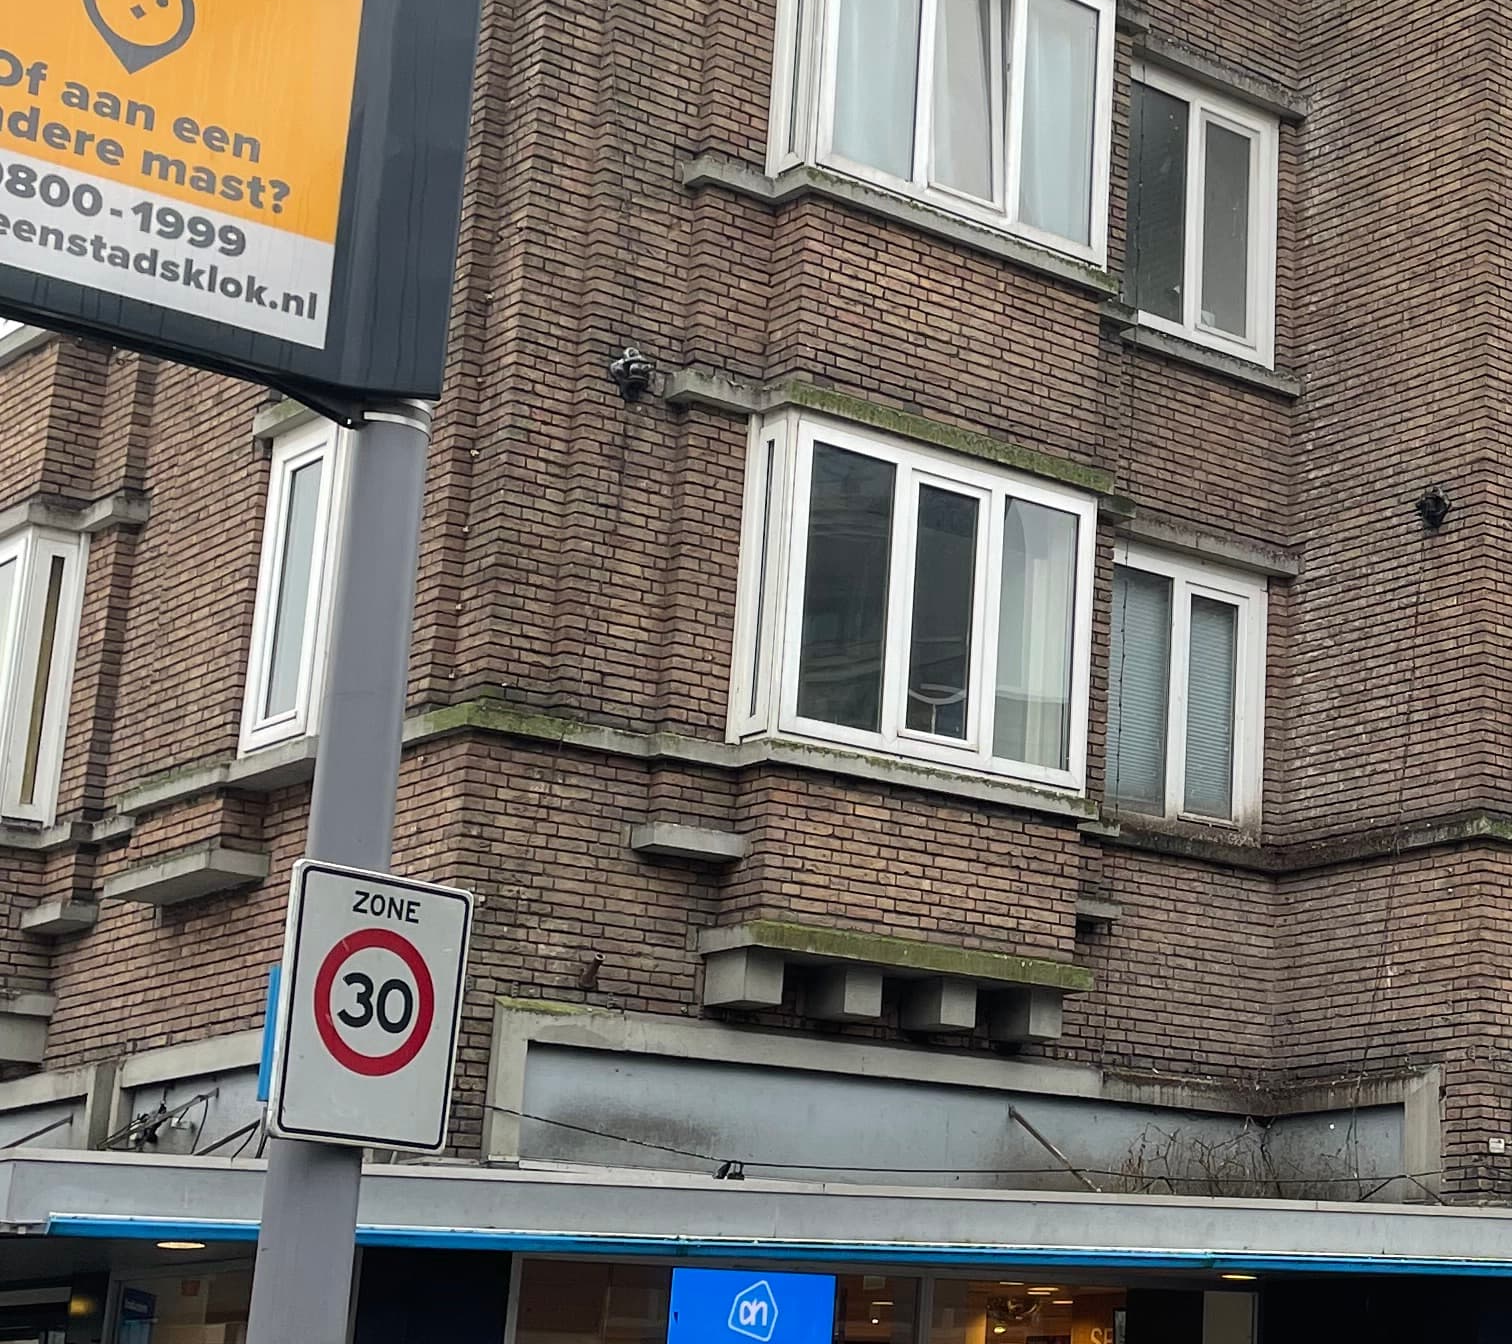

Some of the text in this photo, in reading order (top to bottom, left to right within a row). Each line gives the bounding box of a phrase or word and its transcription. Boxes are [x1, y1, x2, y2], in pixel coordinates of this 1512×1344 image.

[0, 105, 292, 214] dere mast?
[61, 80, 156, 132] aan
[173, 116, 262, 163] een
[0, 161, 247, 258] 800-1999
[352, 890, 421, 924] ZONE
[337, 972, 413, 1034] 30
